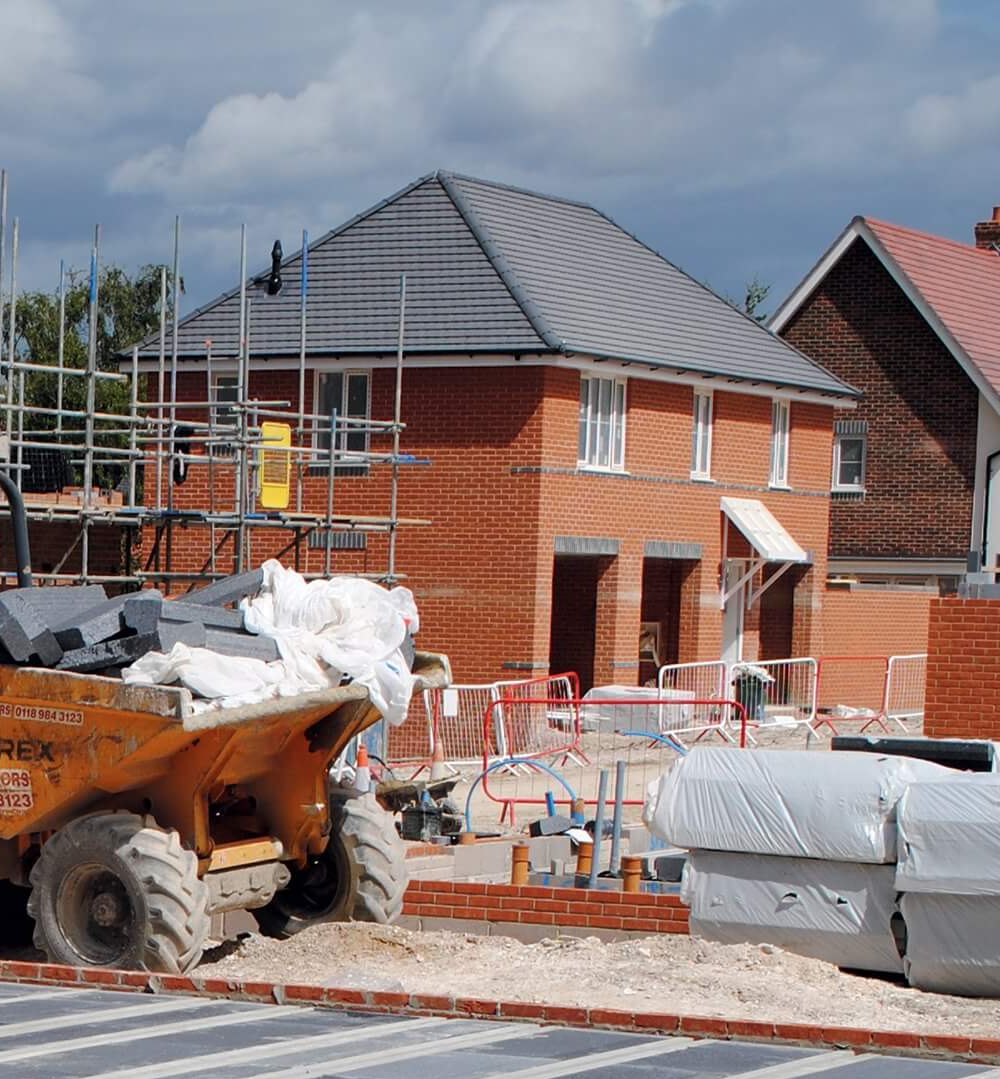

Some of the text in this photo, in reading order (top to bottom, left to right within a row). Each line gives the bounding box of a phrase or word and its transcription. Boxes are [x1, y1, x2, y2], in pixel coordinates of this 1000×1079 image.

[15, 707, 36, 718] 0118
[38, 709, 56, 720] 984
[59, 711, 82, 723] 3123
